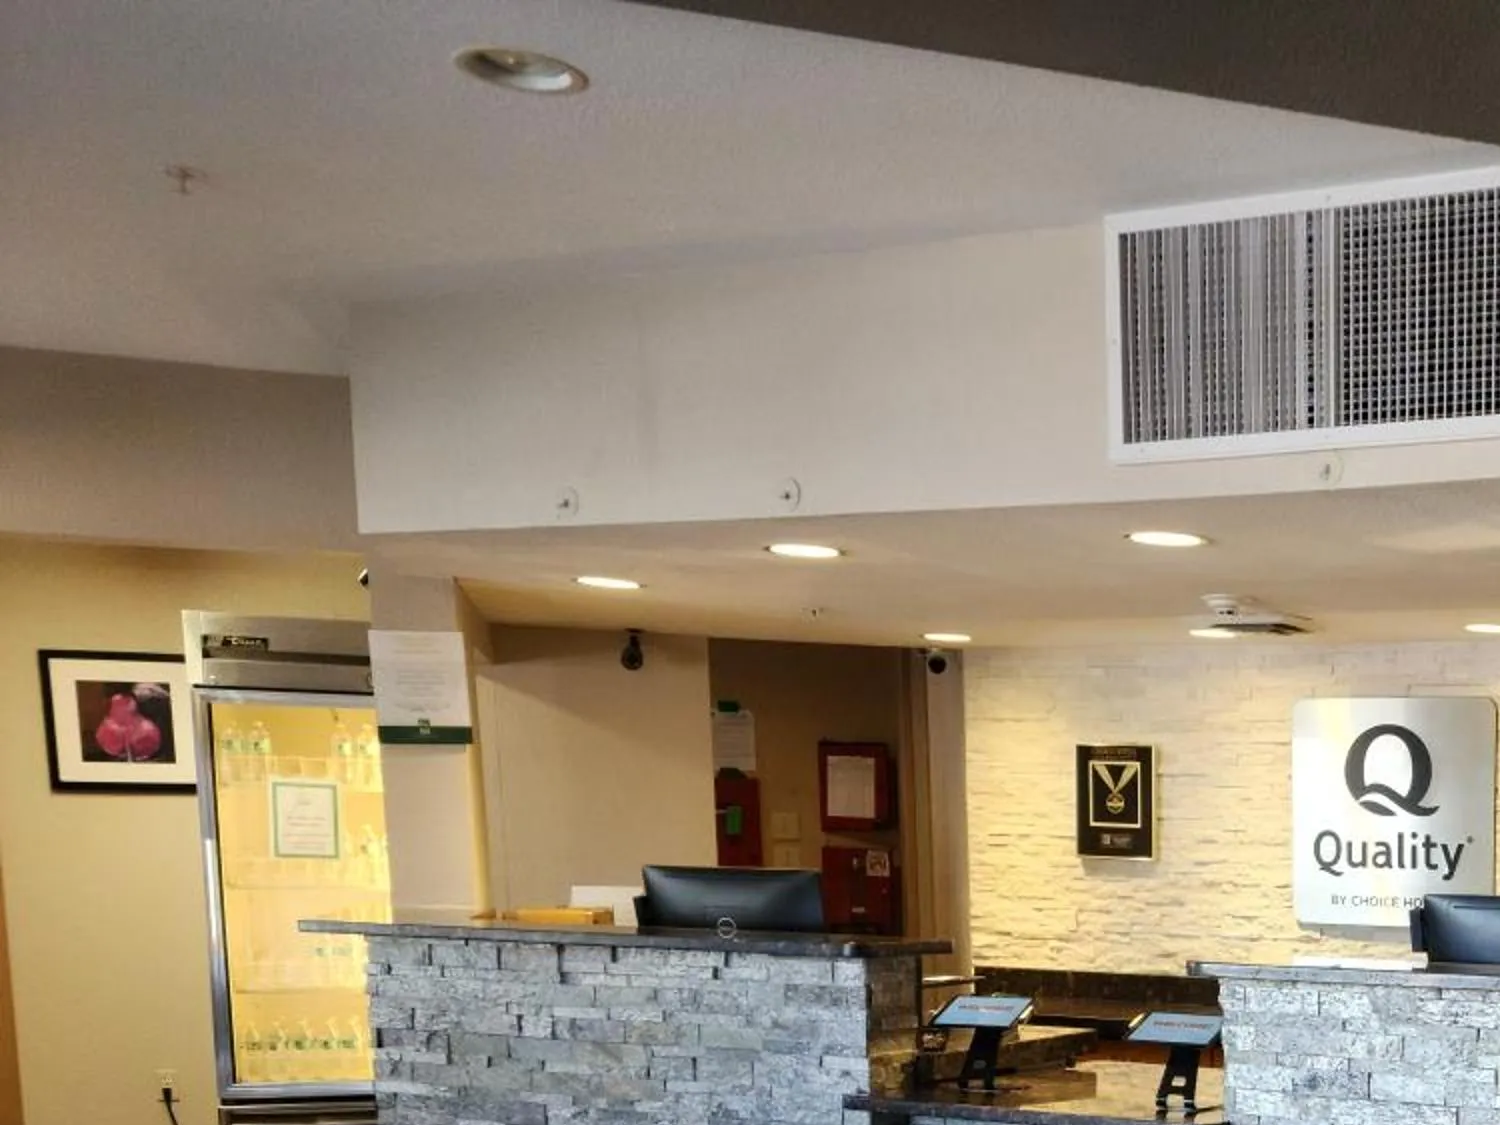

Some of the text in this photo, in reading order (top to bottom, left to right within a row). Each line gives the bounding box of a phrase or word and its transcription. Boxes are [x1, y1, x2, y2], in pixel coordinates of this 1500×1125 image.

[1344, 723, 1440, 817] Q
[1313, 829, 1465, 881] Quality
[1331, 894, 1347, 905] BY
[1351, 895, 1400, 908] CHOICE
